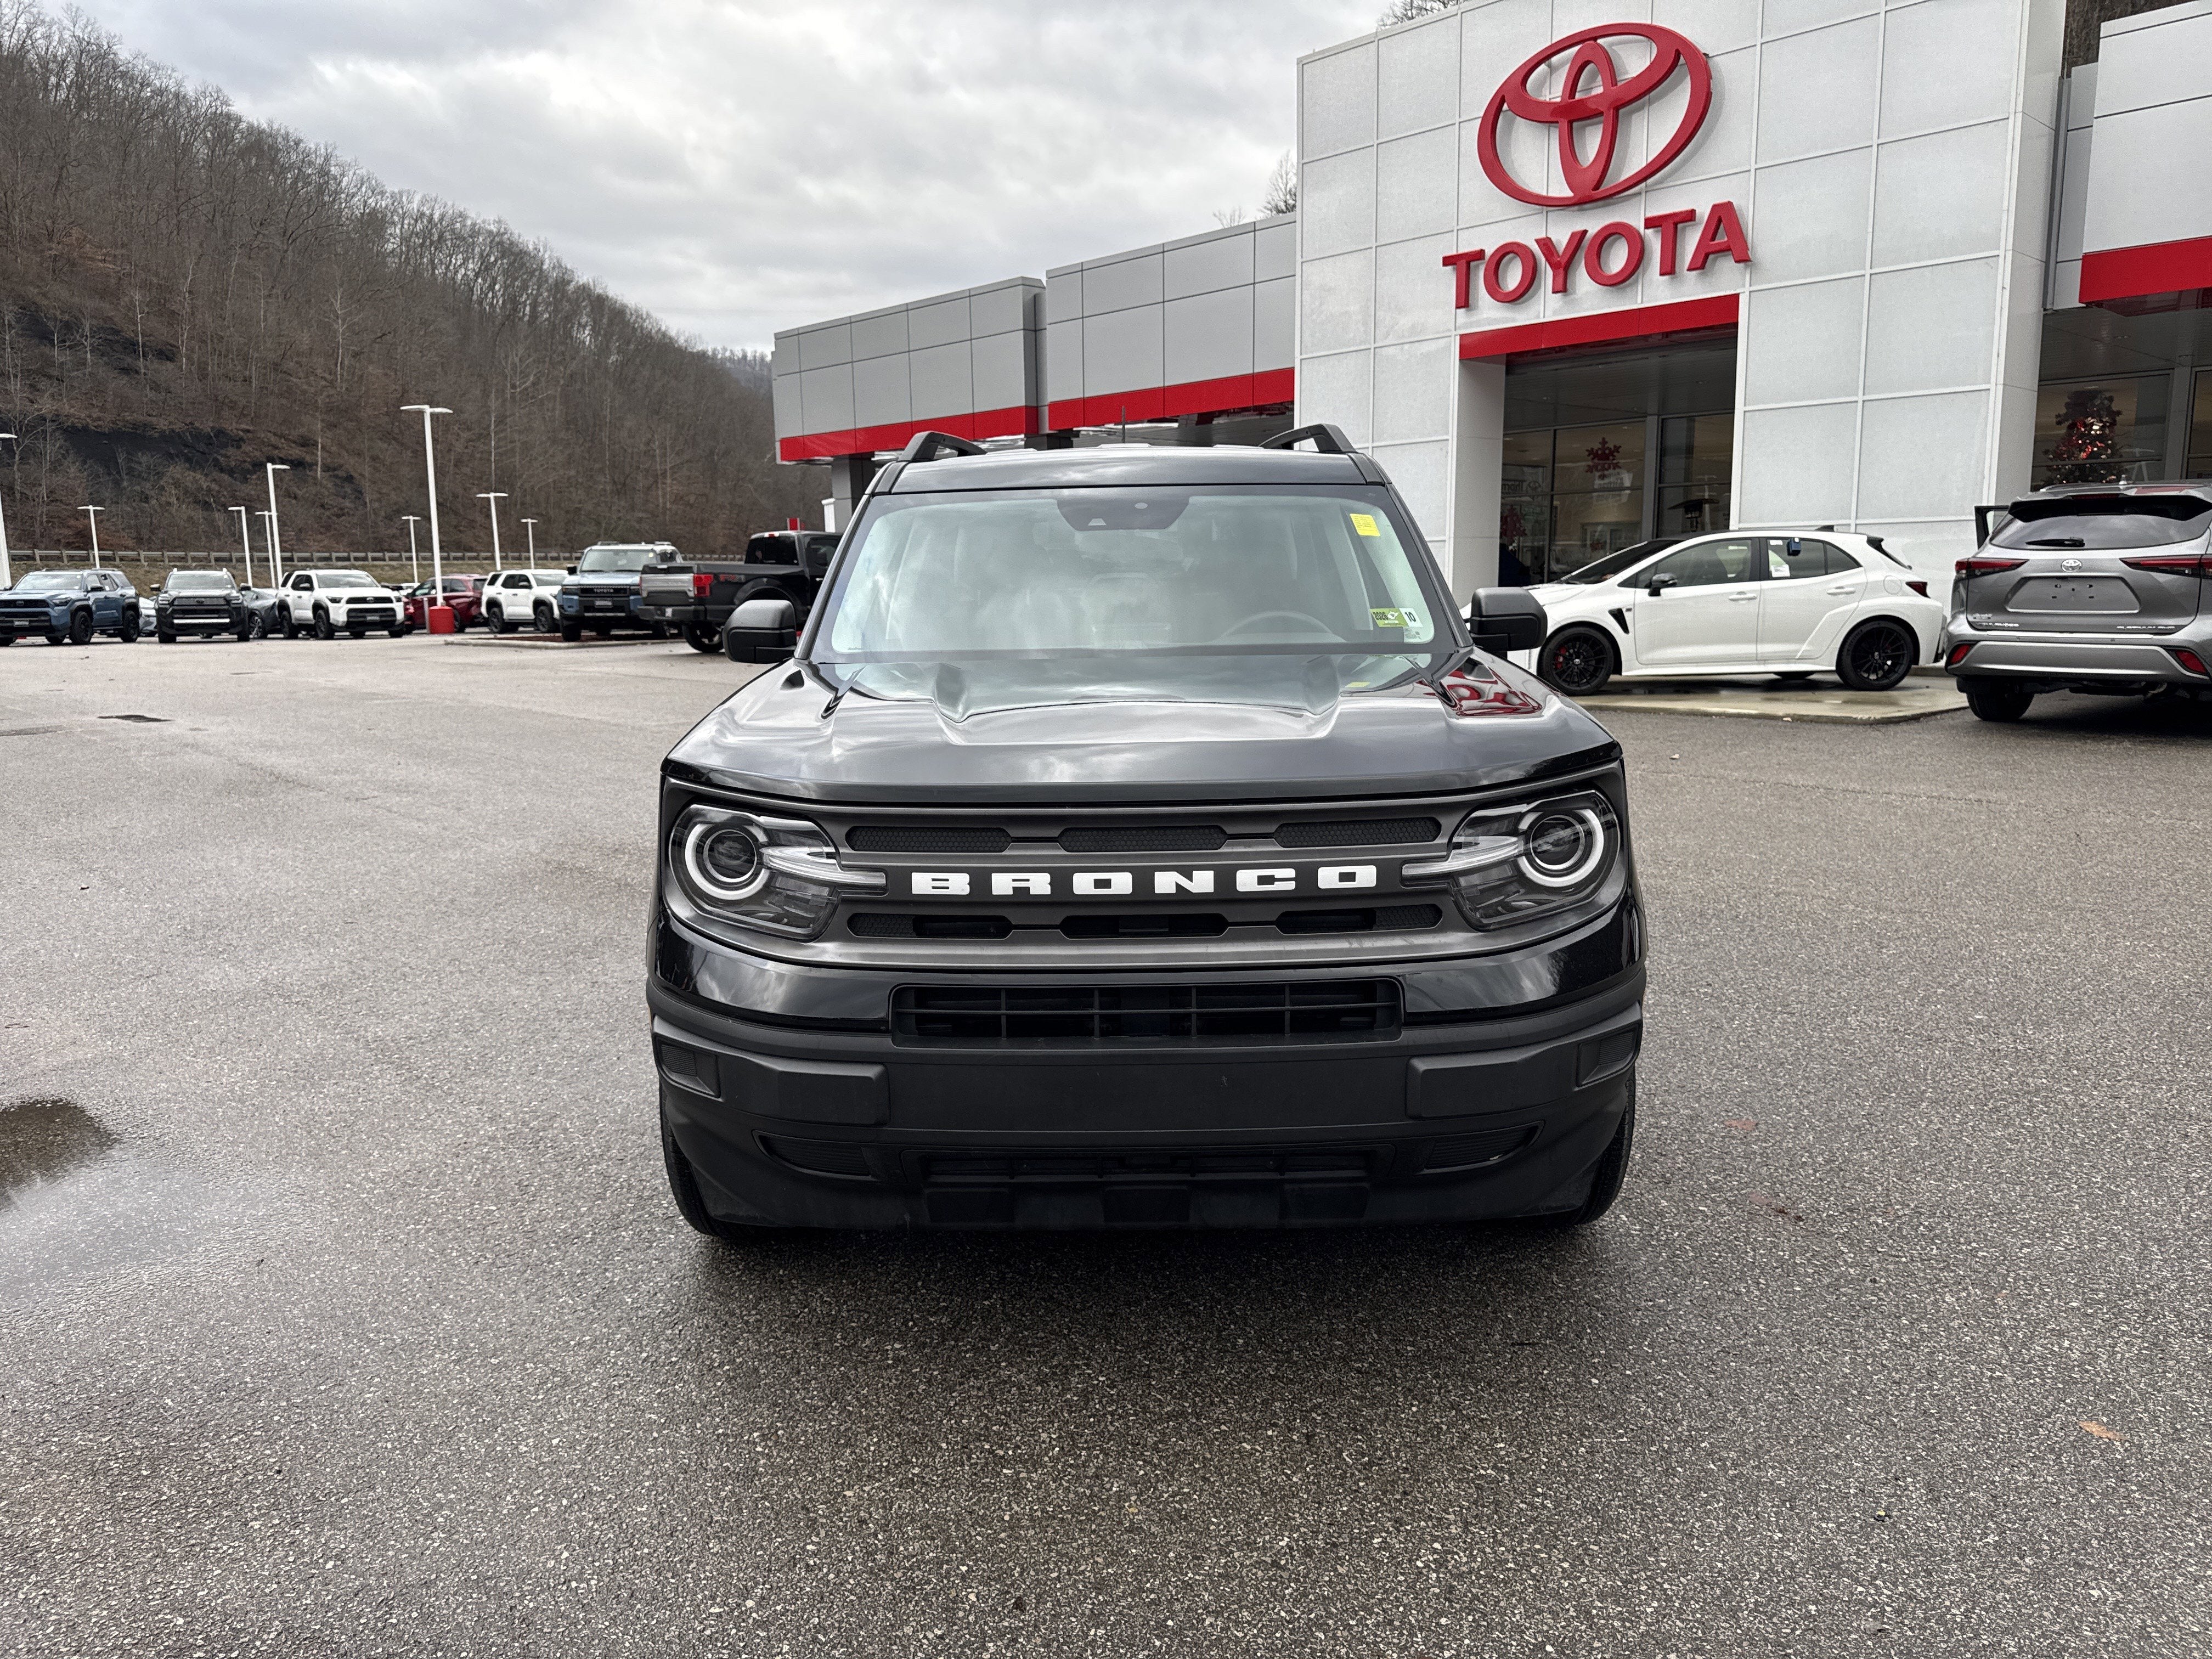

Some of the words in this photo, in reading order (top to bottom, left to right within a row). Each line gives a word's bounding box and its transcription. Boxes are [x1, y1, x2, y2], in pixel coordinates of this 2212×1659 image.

[1442, 201, 1752, 309] TOYOTA
[1373, 611, 1389, 620] 2026
[1404, 612, 1417, 622] 10
[911, 865, 1377, 895] BRONCO
